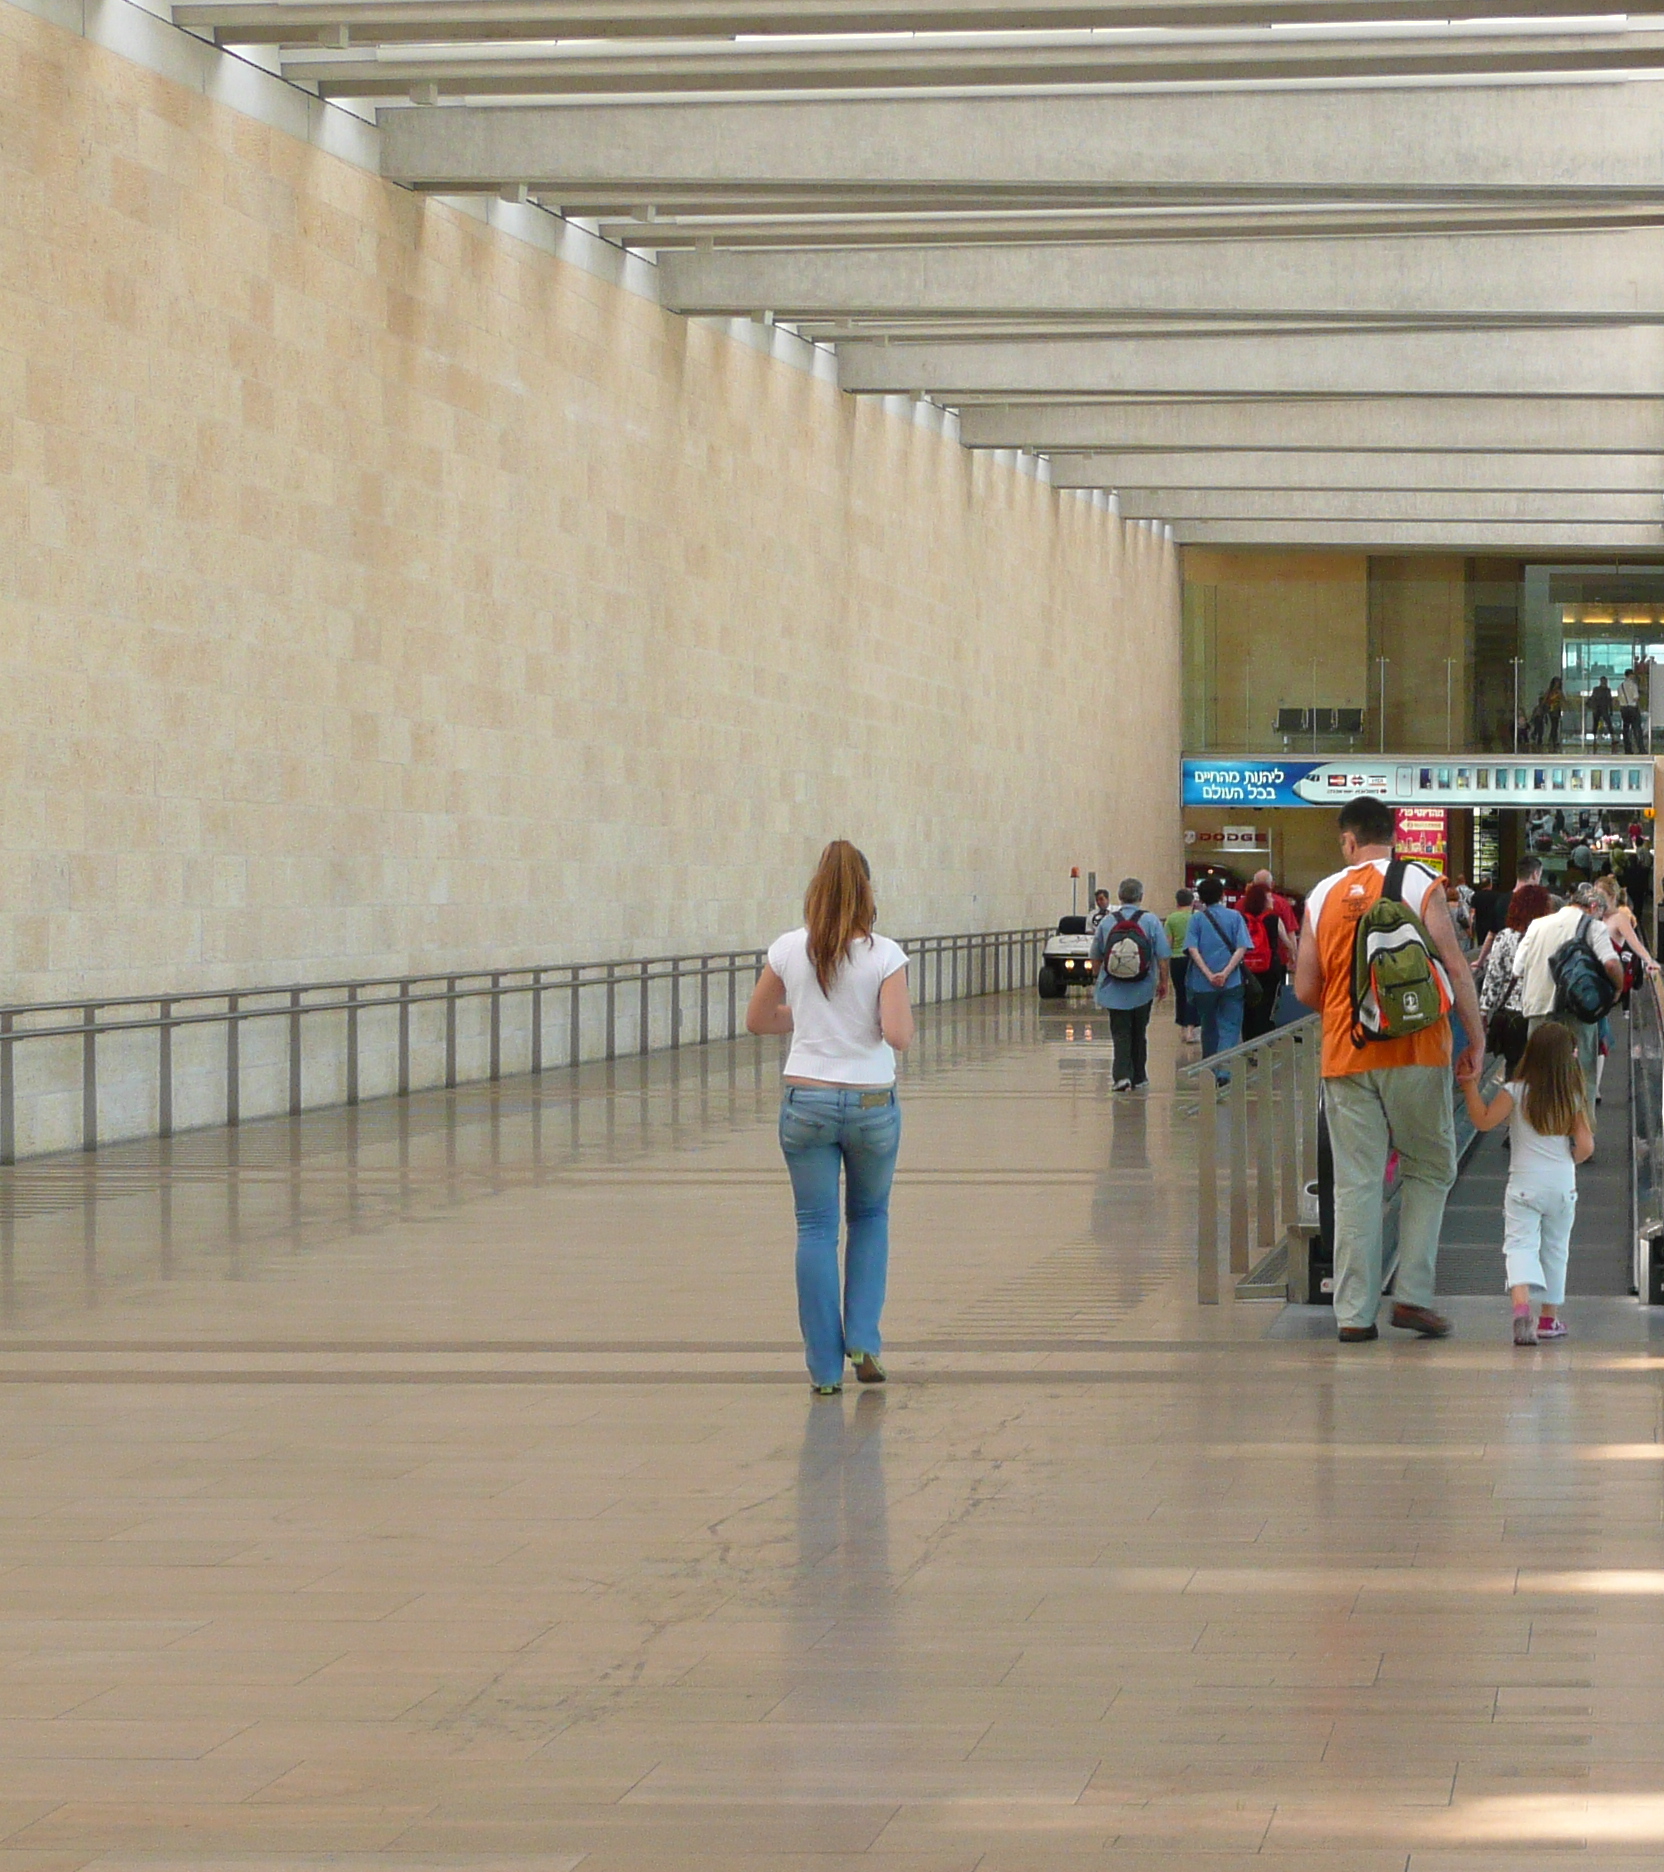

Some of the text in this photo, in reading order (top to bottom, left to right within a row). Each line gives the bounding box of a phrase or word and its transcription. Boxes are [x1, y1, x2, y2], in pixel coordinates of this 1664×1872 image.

[1194, 767, 1285, 785] ליהנות מהחיים
[1202, 783, 1276, 799] בכל העולם
[1199, 832, 1267, 841] DODGE
